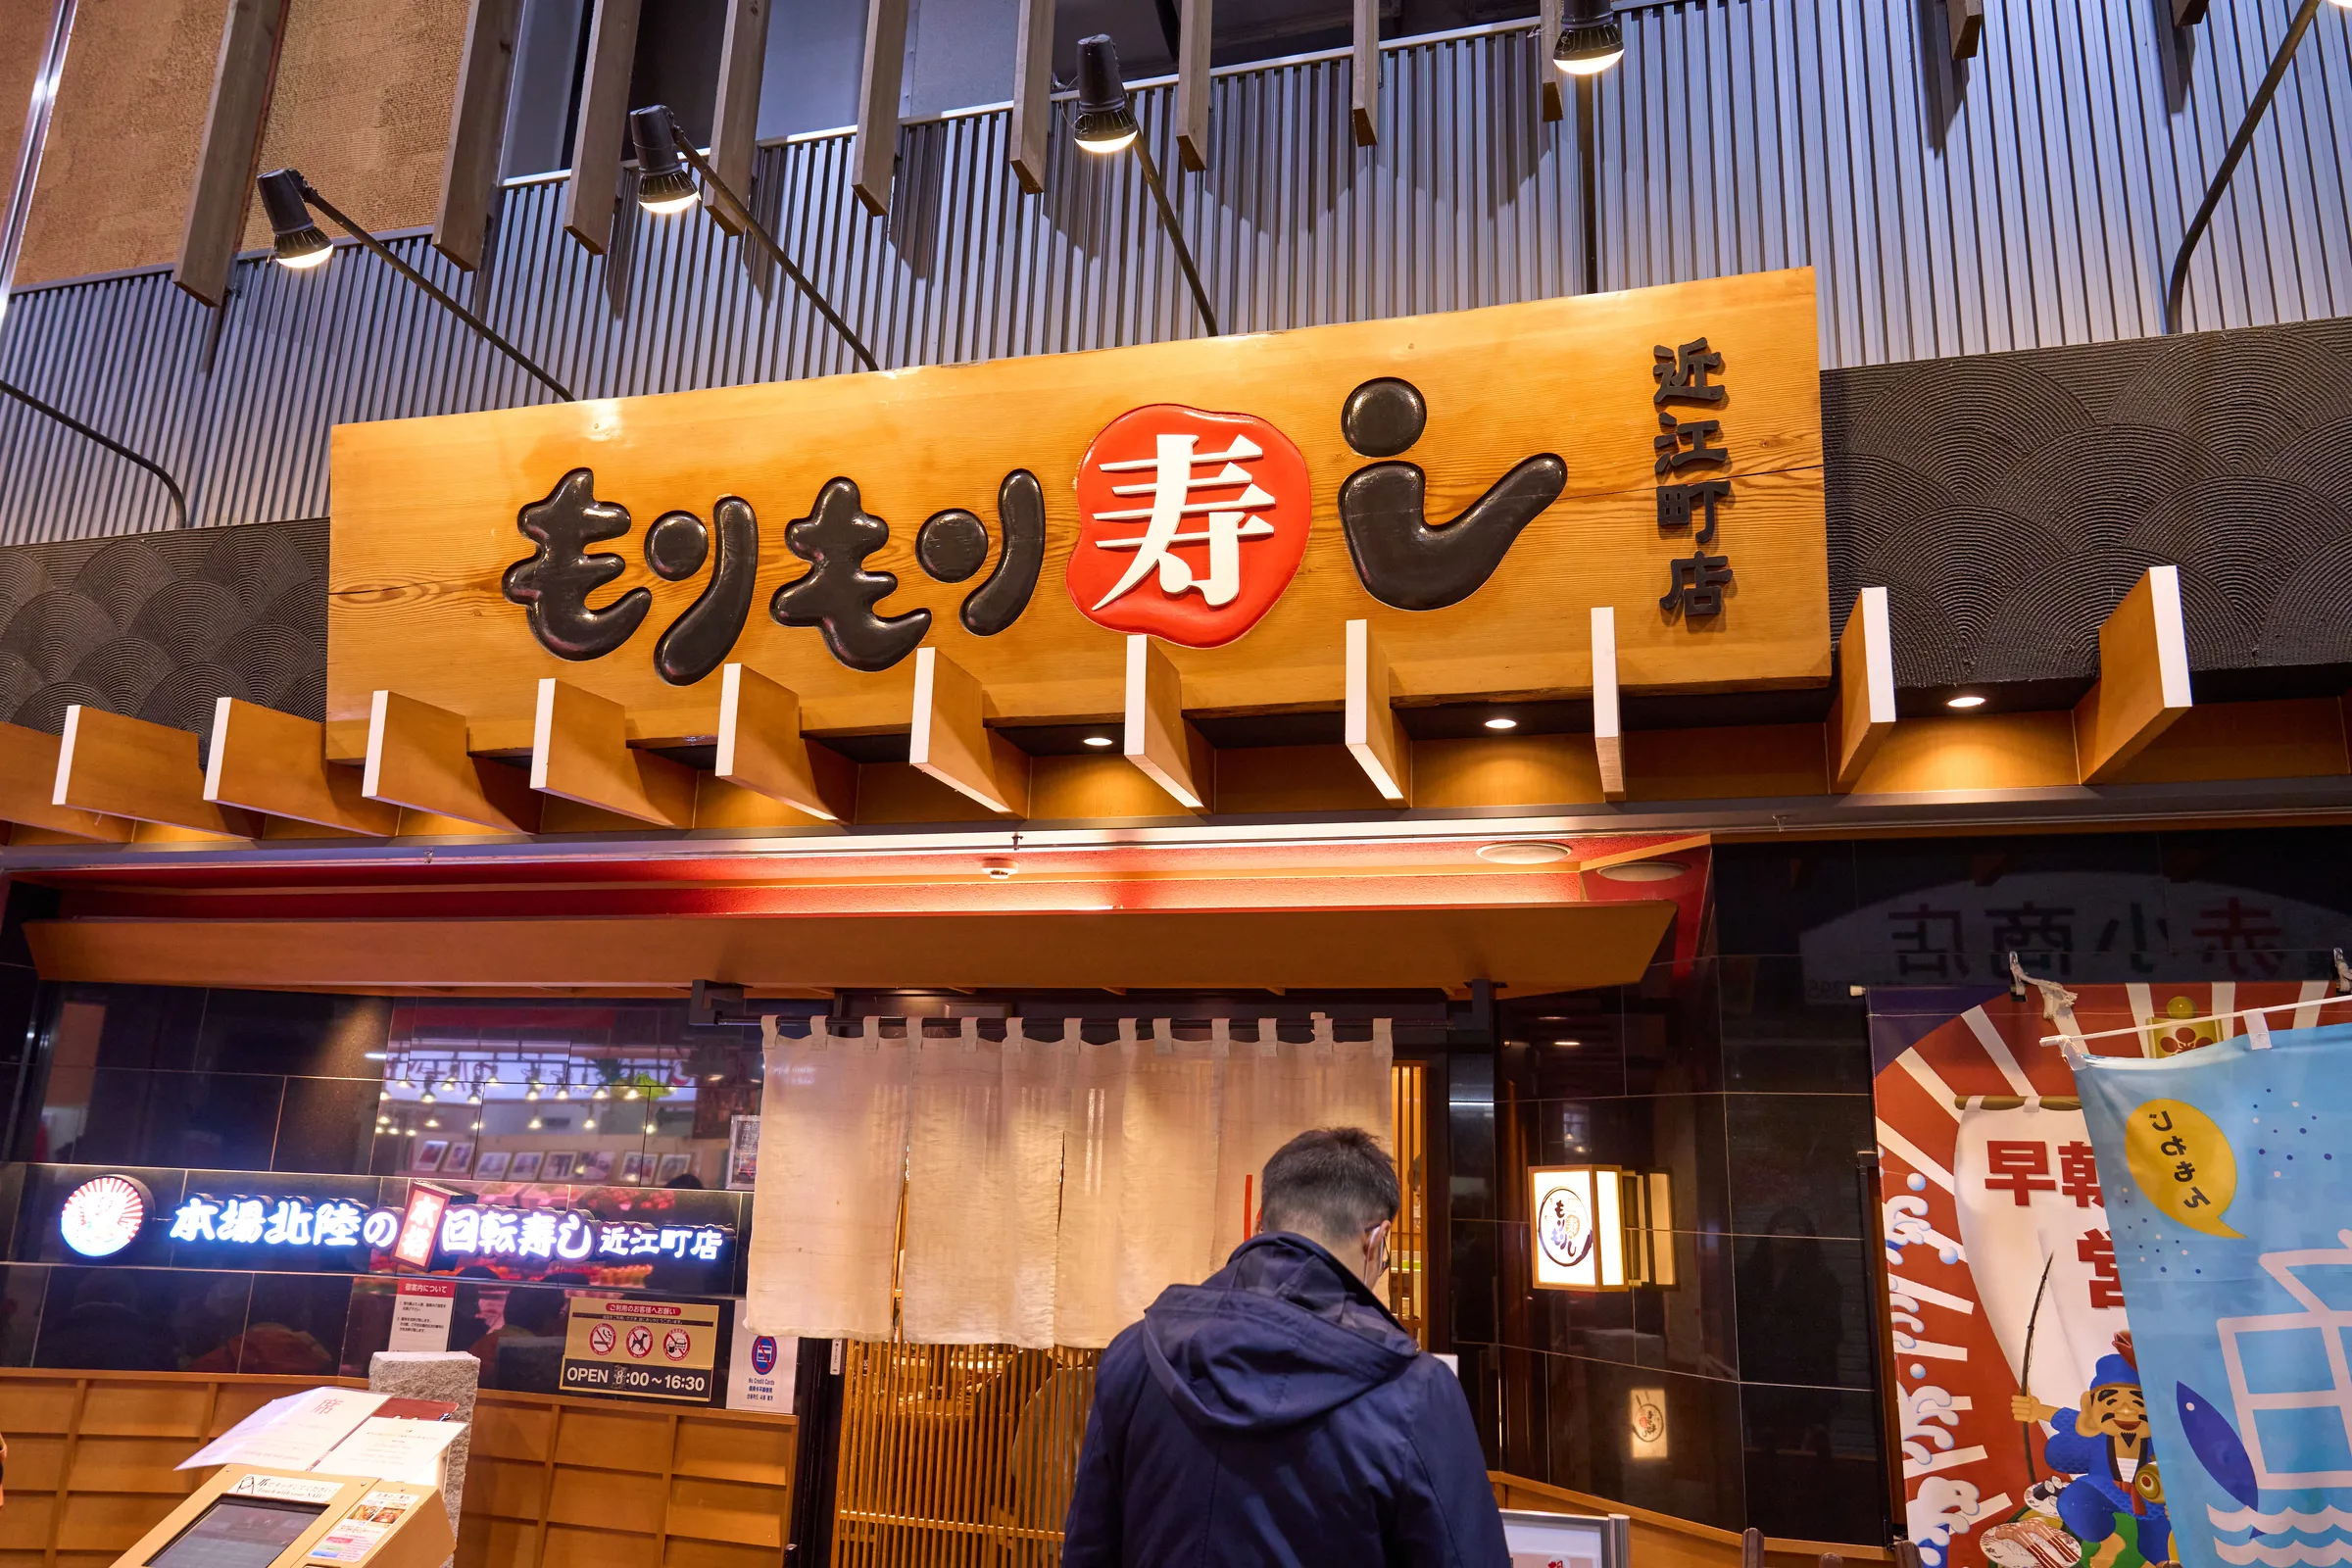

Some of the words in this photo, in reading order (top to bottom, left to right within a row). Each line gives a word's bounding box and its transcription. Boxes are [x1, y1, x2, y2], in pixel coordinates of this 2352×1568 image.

[1652, 336, 1734, 617] 近江町店
[171, 1198, 398, 1248] 本場北陸の
[442, 1208, 592, 1259] 回転寿し
[599, 1225, 723, 1260] 近江町店
[405, 1283, 448, 1294] 御案内について
[609, 1303, 677, 1315] ご利用のお客様へお願い
[566, 1366, 610, 1384] OPEN
